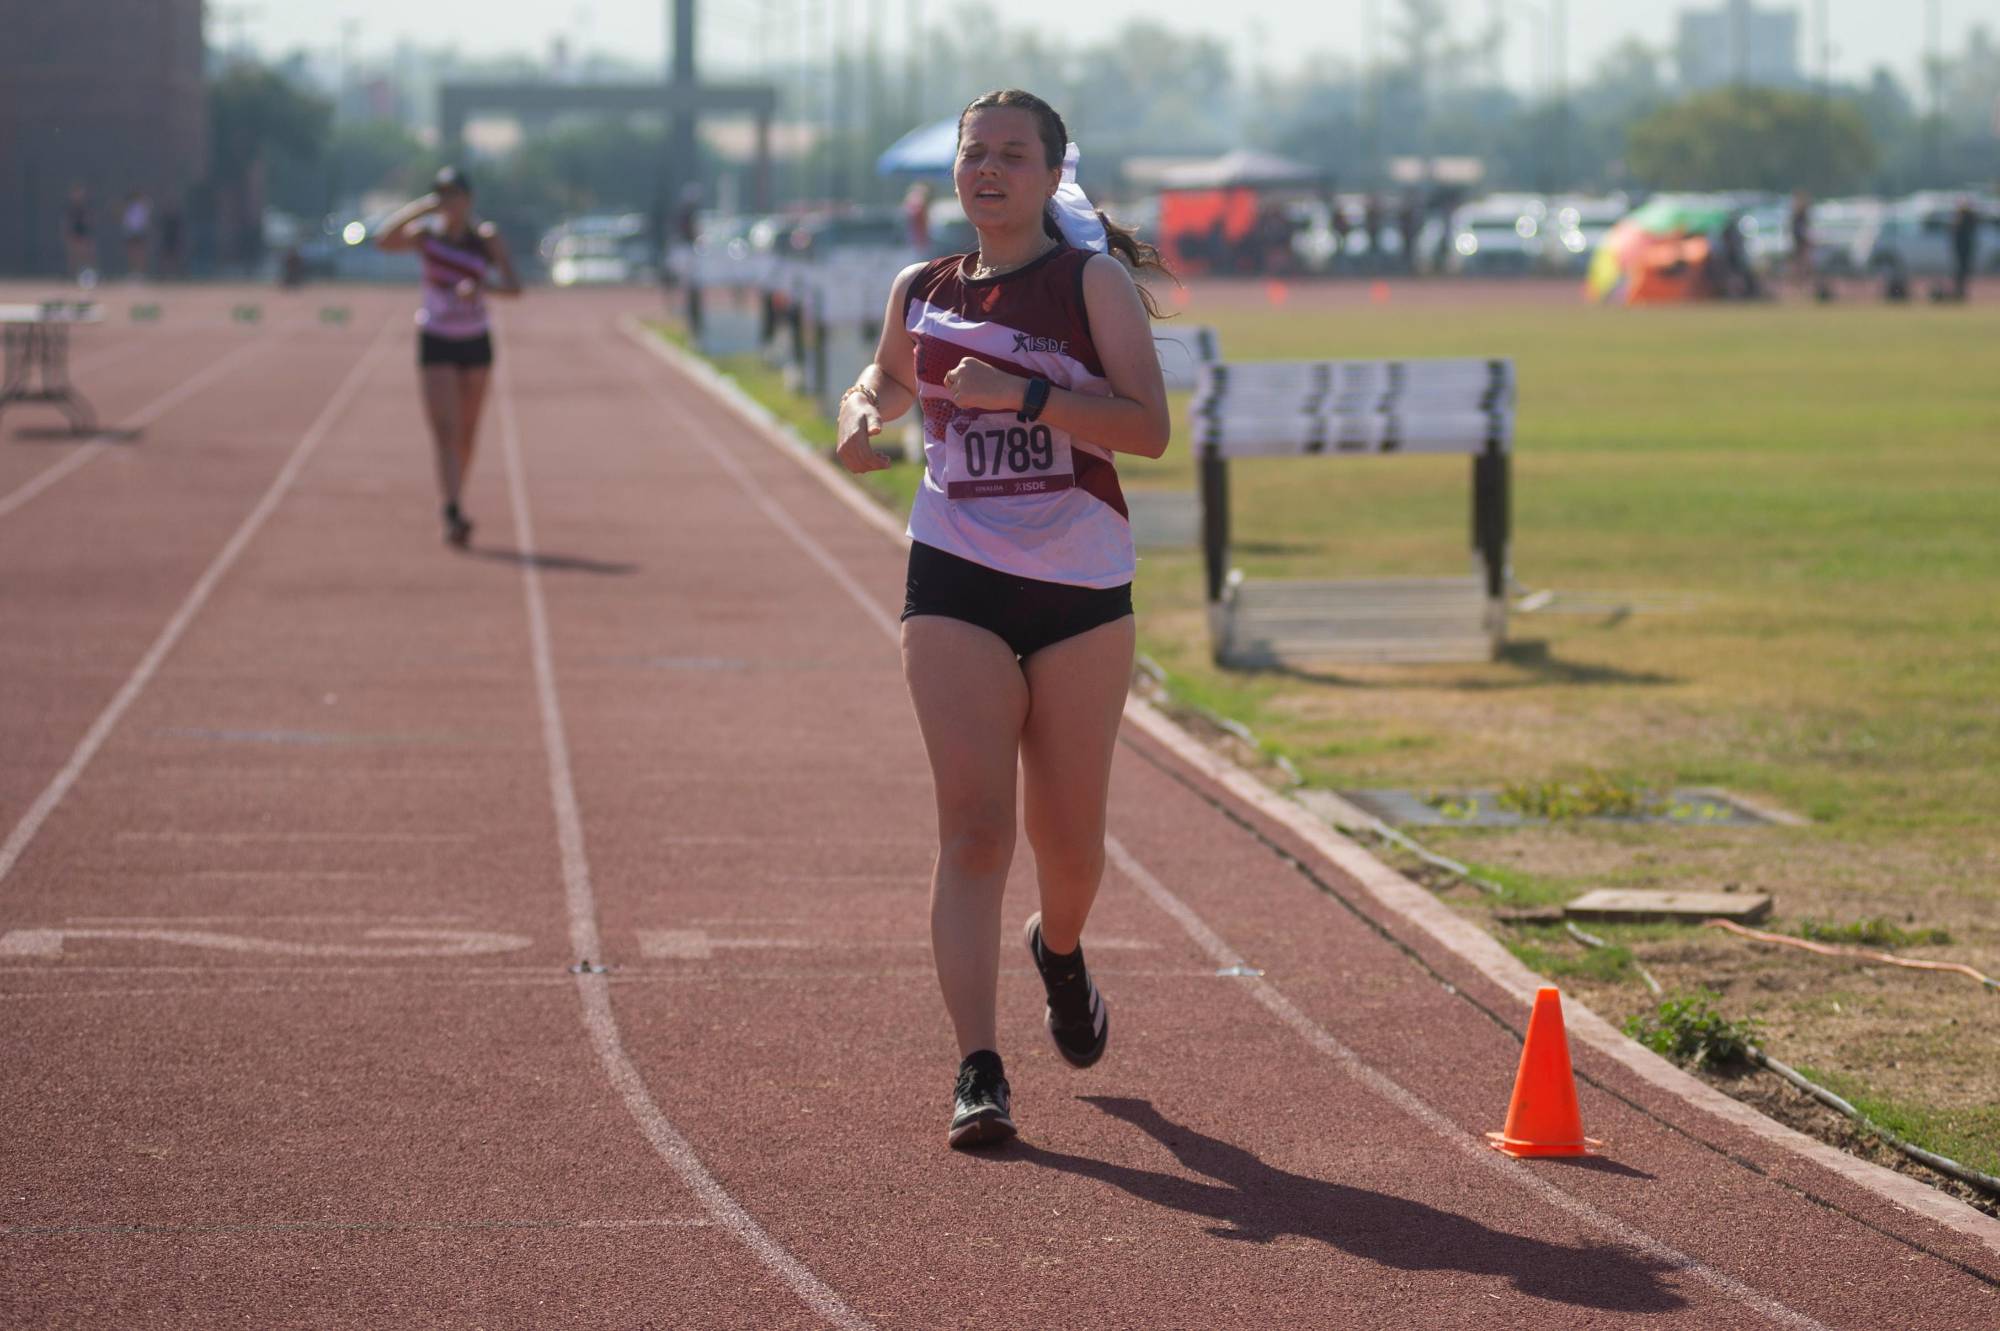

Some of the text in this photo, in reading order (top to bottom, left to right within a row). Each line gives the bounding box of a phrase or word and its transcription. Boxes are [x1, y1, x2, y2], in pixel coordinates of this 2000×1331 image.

[1030, 335, 1069, 354] ISDE
[965, 424, 1053, 477] 0789
[1022, 480, 1046, 491] ISDE
